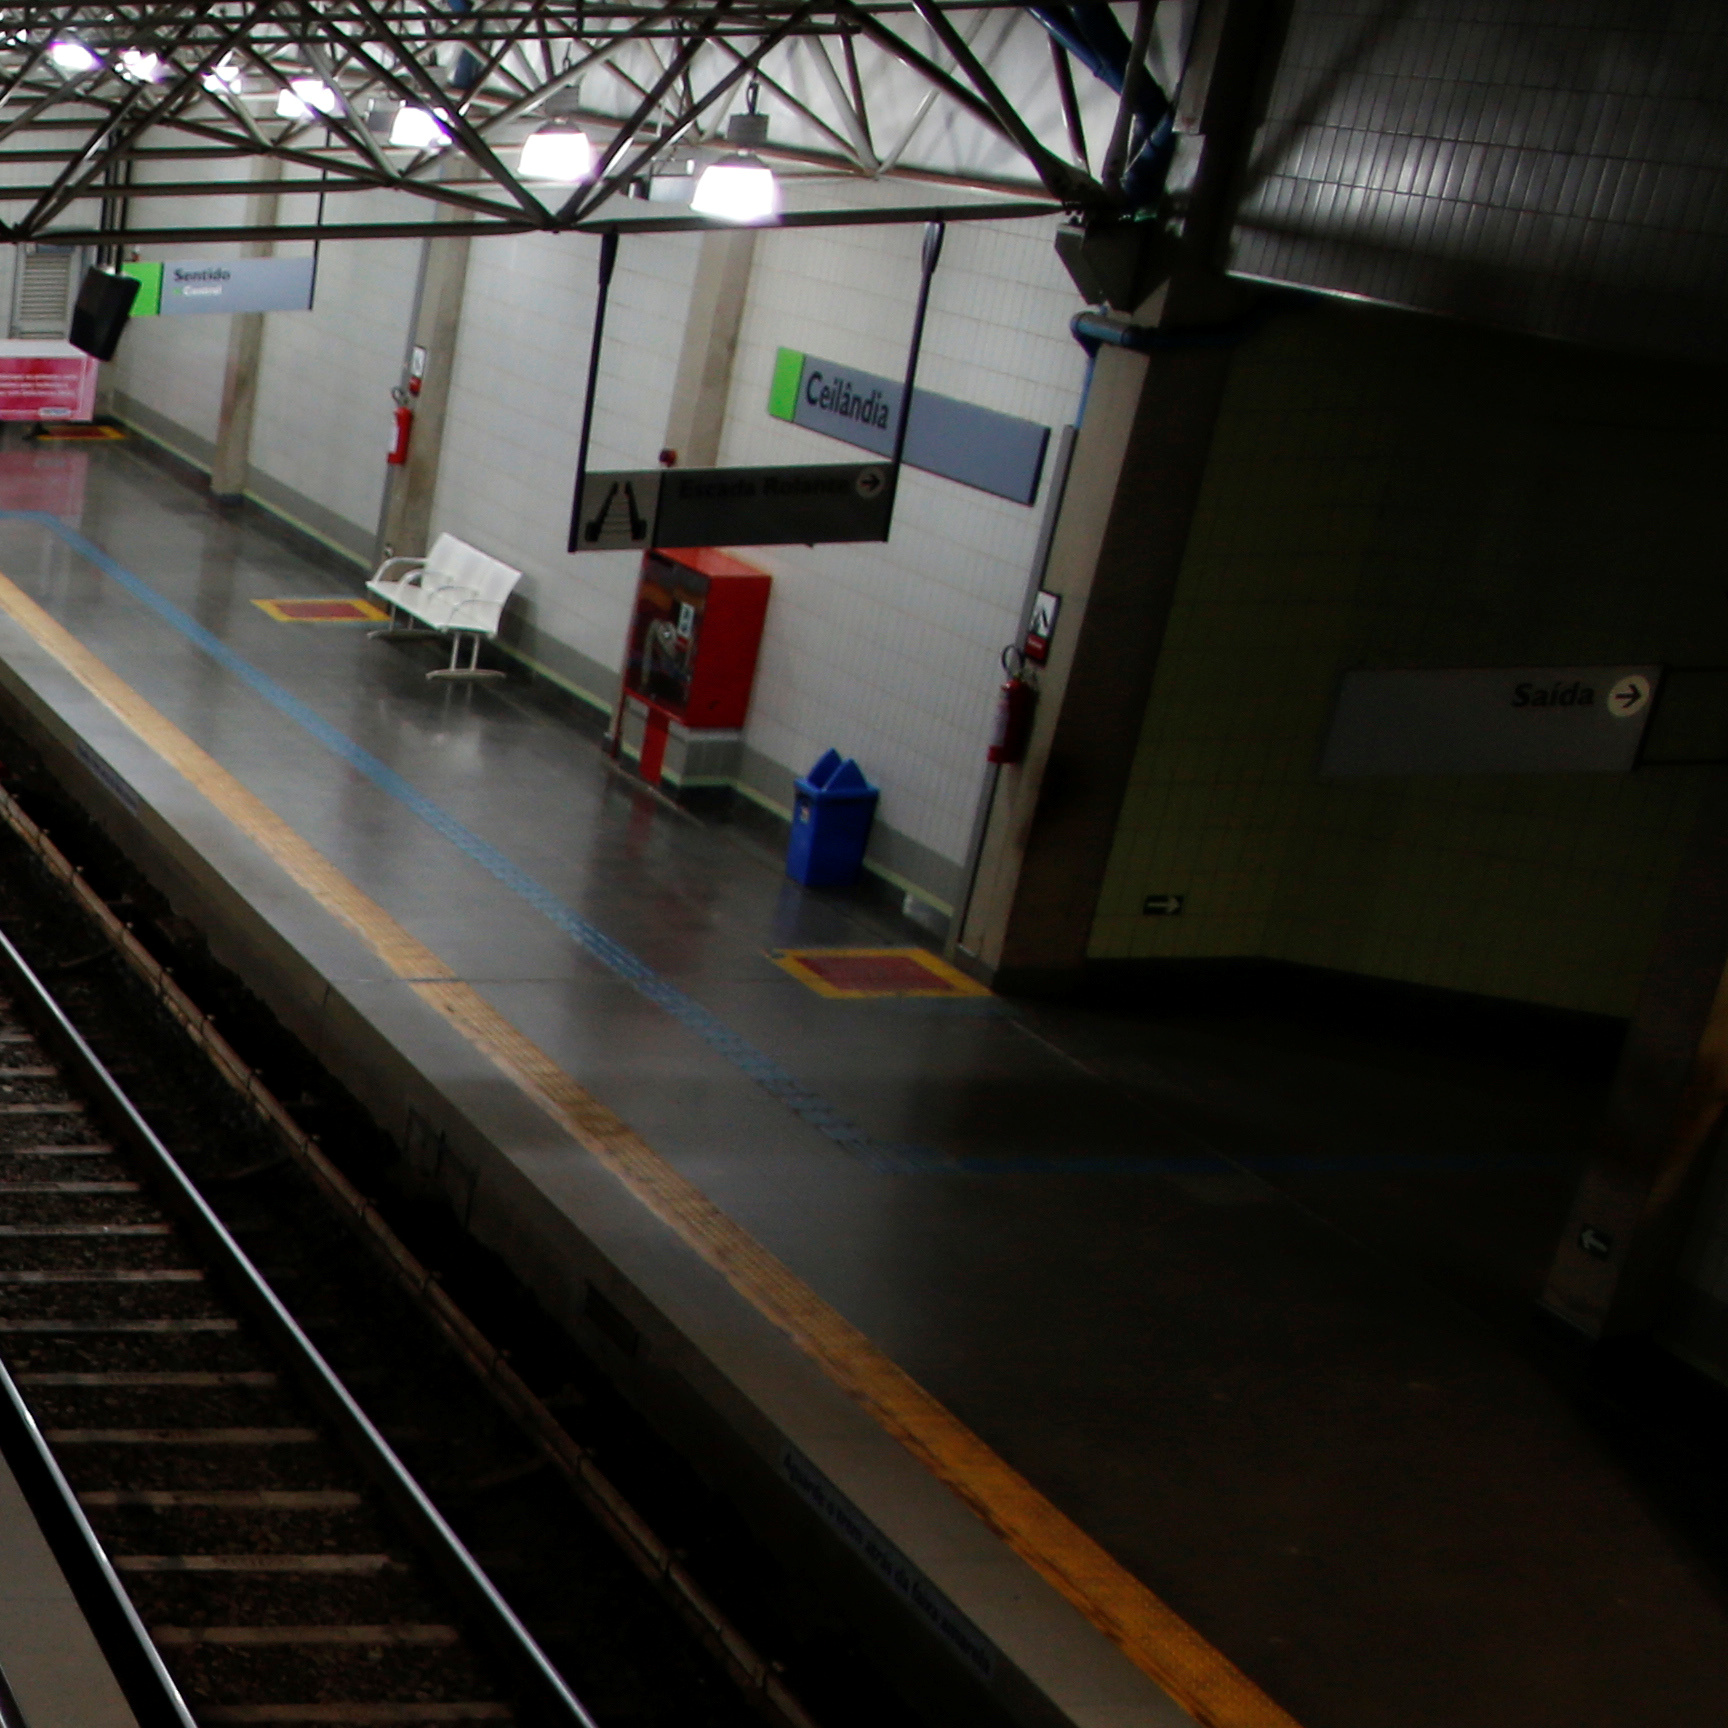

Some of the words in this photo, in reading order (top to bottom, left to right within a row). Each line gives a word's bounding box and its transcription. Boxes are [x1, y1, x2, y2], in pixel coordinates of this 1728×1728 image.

[173, 267, 231, 282] Sentido
[806, 370, 889, 430] Ceilândia
[1511, 682, 1594, 707] Saída
